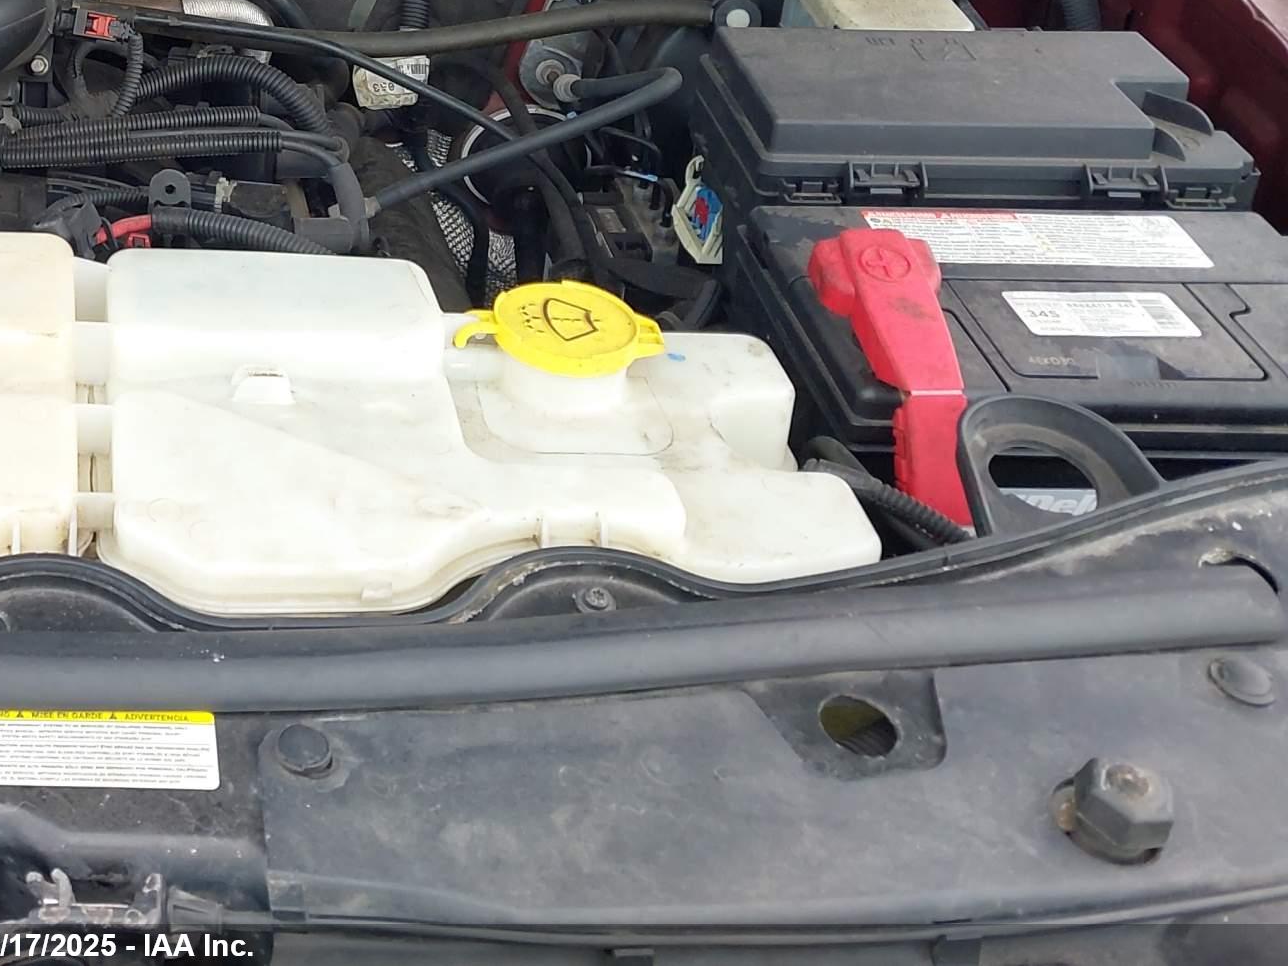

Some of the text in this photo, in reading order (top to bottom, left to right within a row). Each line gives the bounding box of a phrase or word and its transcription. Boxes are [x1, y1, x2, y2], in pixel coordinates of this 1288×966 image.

[31, 711, 54, 720] MISE
[56, 712, 69, 720] EN
[71, 712, 104, 721] GARDE
[124, 713, 190, 722] ADVERTENCIA
